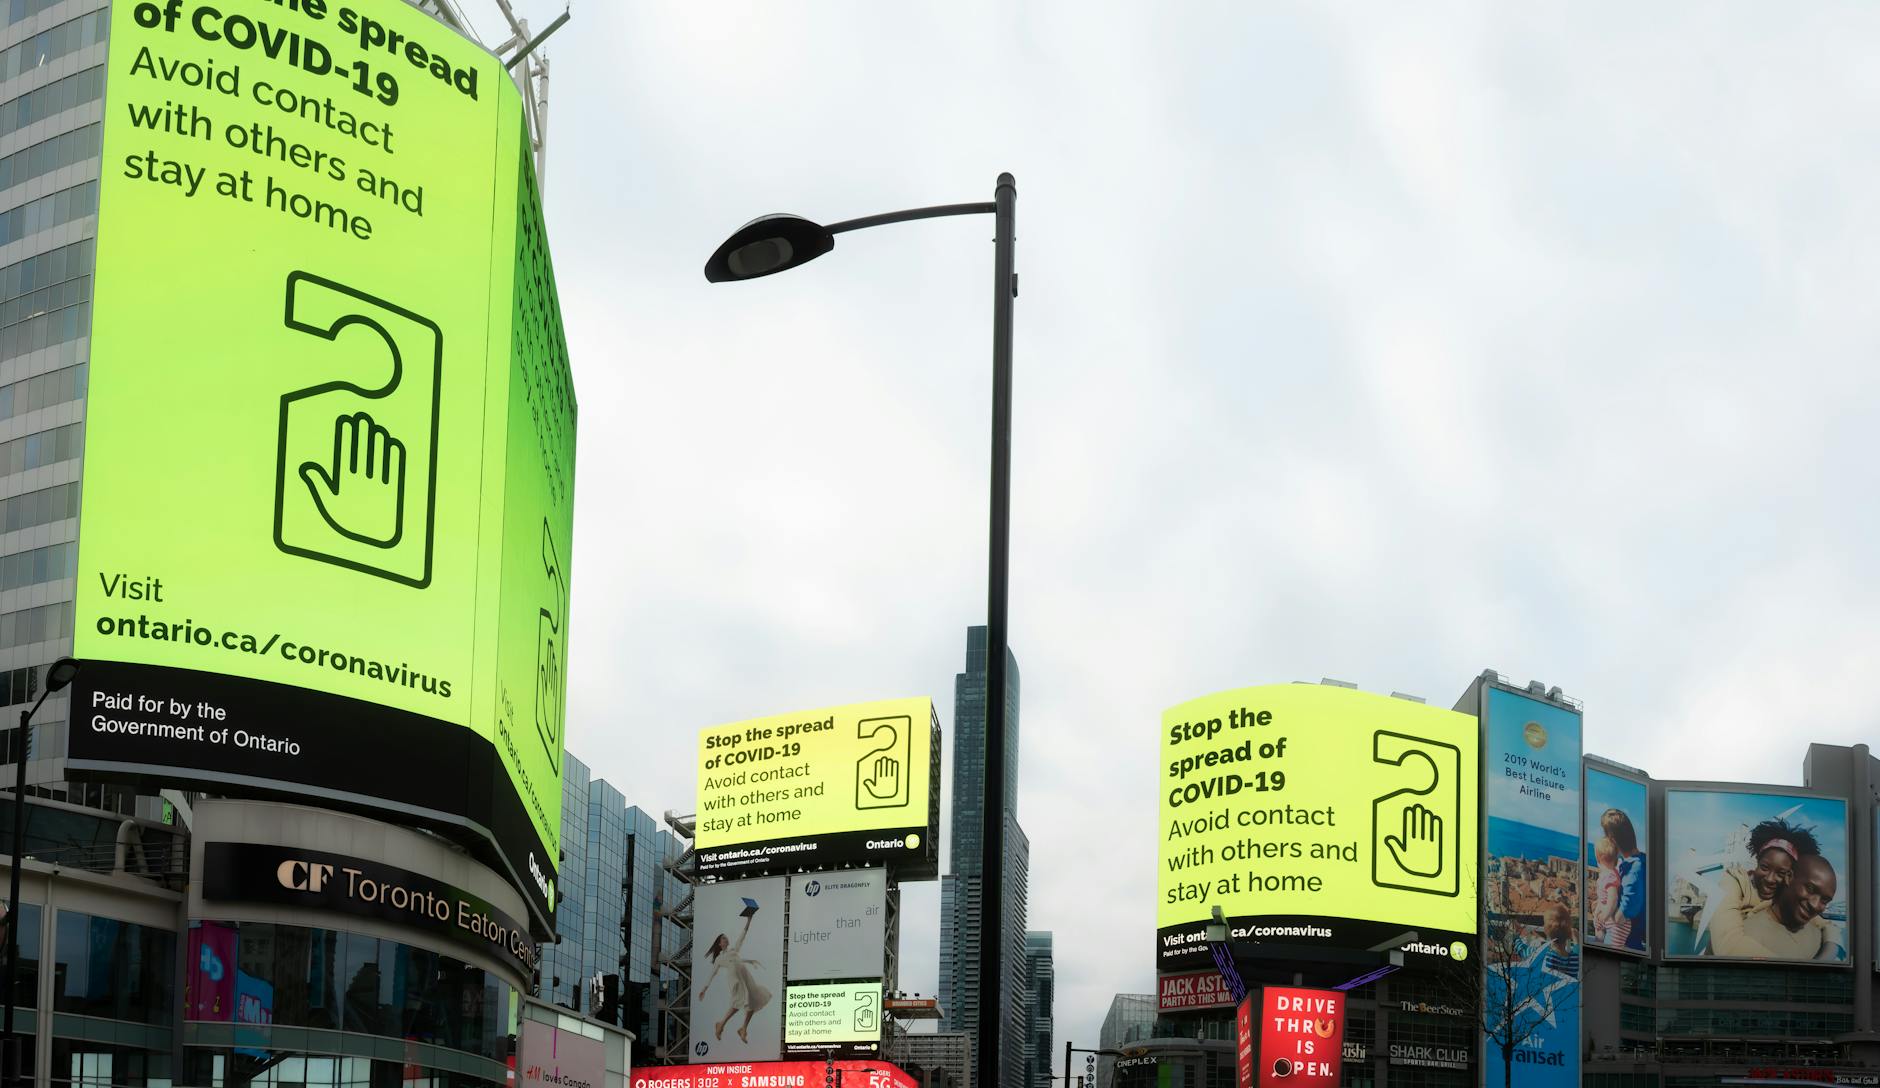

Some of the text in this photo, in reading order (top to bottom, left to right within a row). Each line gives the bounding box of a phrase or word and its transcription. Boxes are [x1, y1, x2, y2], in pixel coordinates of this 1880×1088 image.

[133, 0, 399, 107] of COVID-19
[337, 7, 478, 107] spread
[129, 46, 394, 154] Avoid contact
[128, 103, 423, 217] with others and
[123, 150, 373, 241] stay at home
[99, 572, 164, 603] Visit
[96, 614, 452, 698] ontario.ca/coronavirus
[92, 691, 227, 721] Paid for by the
[91, 714, 301, 756] Government of Ontario
[706, 716, 833, 750] Stop the spread
[1170, 708, 1272, 746] Stop the
[705, 743, 801, 770] of COVID-19
[1169, 737, 1287, 779] spread of
[1504, 752, 1566, 778] 2019 World's
[704, 763, 810, 791] Avoid contact
[1169, 771, 1286, 808] COVID-19
[1506, 767, 1565, 790] Best Leisure
[704, 782, 824, 811] with others and
[1520, 785, 1551, 801] Airline
[703, 810, 801, 833] stay at home
[1168, 804, 1336, 841] Avoid contact
[701, 842, 817, 862] Visit ontario.ca/coronavirus
[866, 838, 905, 850] Ontario
[1168, 839, 1358, 872] with others and
[529, 852, 547, 898] Ontario
[805, 880, 820, 897] hp
[1167, 871, 1323, 904] stay at home
[277, 860, 333, 892] CF
[342, 867, 450, 920] Toronto
[457, 900, 506, 947] Eaton
[794, 905, 879, 944] Lighter than air
[1163, 933, 1185, 947] Visit
[1162, 978, 1194, 996] JACK
[1162, 995, 1187, 1007] PARTY
[1188, 994, 1196, 1005] IS
[1197, 993, 1216, 1004] THIS
[1277, 996, 1335, 1014] DRIVE
[695, 1040, 708, 1056] hp
[1297, 1040, 1314, 1055] IS
[1390, 1045, 1468, 1063] SHARK CLUB
[1522, 1033, 1545, 1049] Air
[707, 1065, 752, 1074] NOW INSIDE
[1117, 1056, 1157, 1068] CINEPLEX
[1502, 1047, 1565, 1067] ransat
[543, 1069, 561, 1084] loves
[648, 1078, 691, 1088] ROGERS
[698, 1077, 719, 1088] 302
[741, 1075, 804, 1088] SAMSUNG
[870, 1076, 890, 1088] 5G
